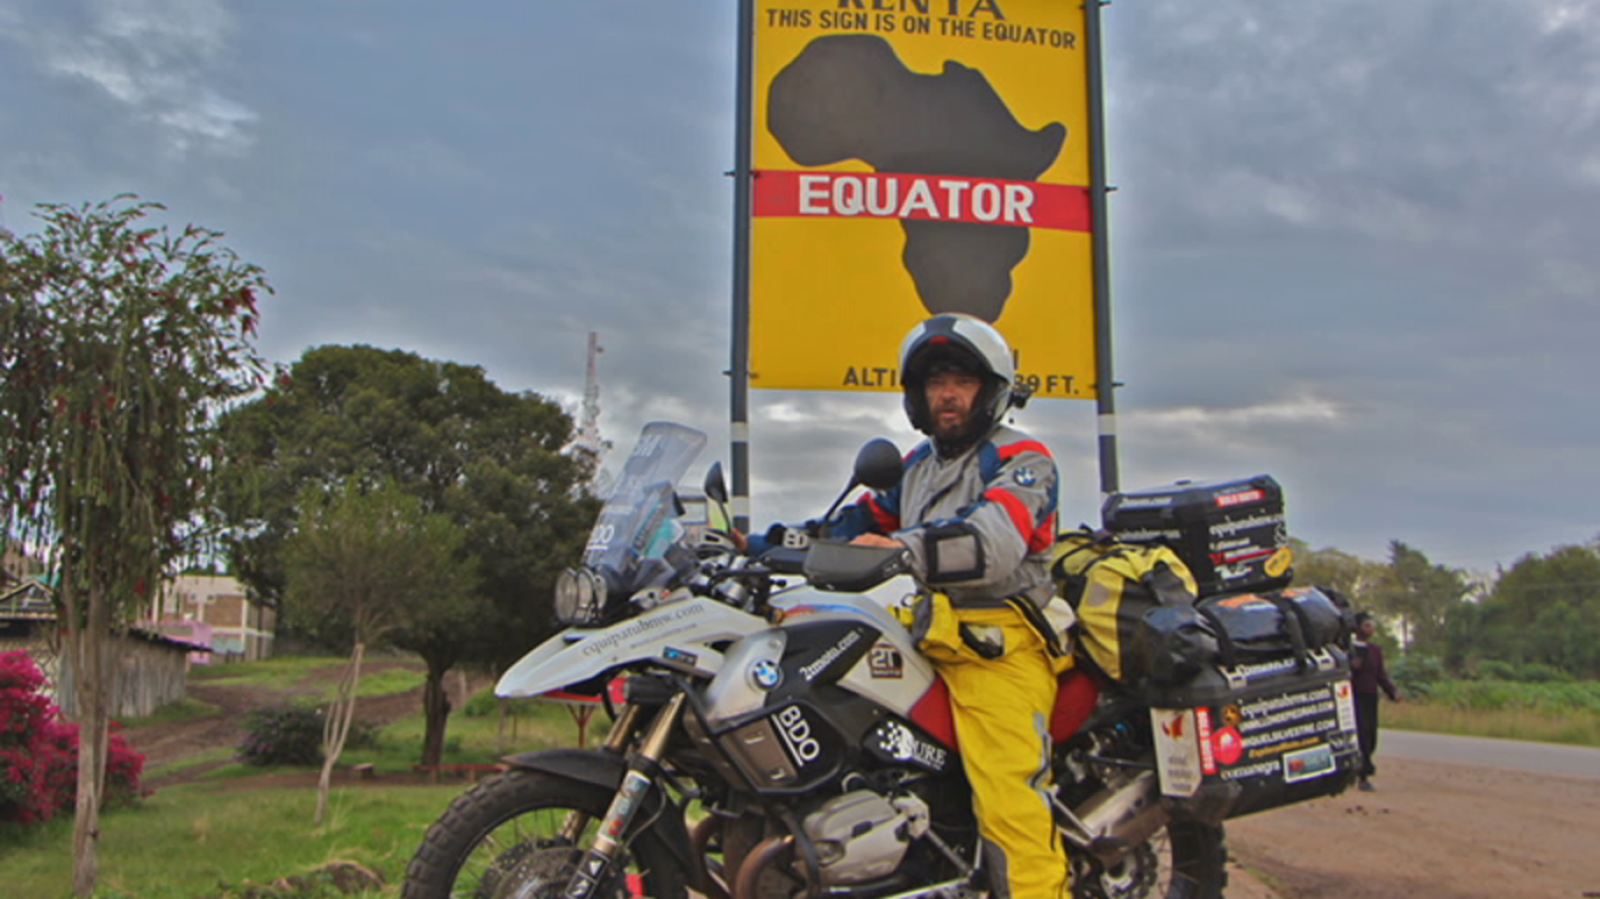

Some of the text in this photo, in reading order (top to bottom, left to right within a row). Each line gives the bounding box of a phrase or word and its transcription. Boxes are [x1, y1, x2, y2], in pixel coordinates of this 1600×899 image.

[767, 9, 1076, 49] THIS SIGN IS ON THE EQUATOR
[799, 174, 1033, 223] EQUATOR
[843, 366, 896, 387] ALTI
[1046, 374, 1079, 395] FT.
[779, 705, 820, 761] BDO
